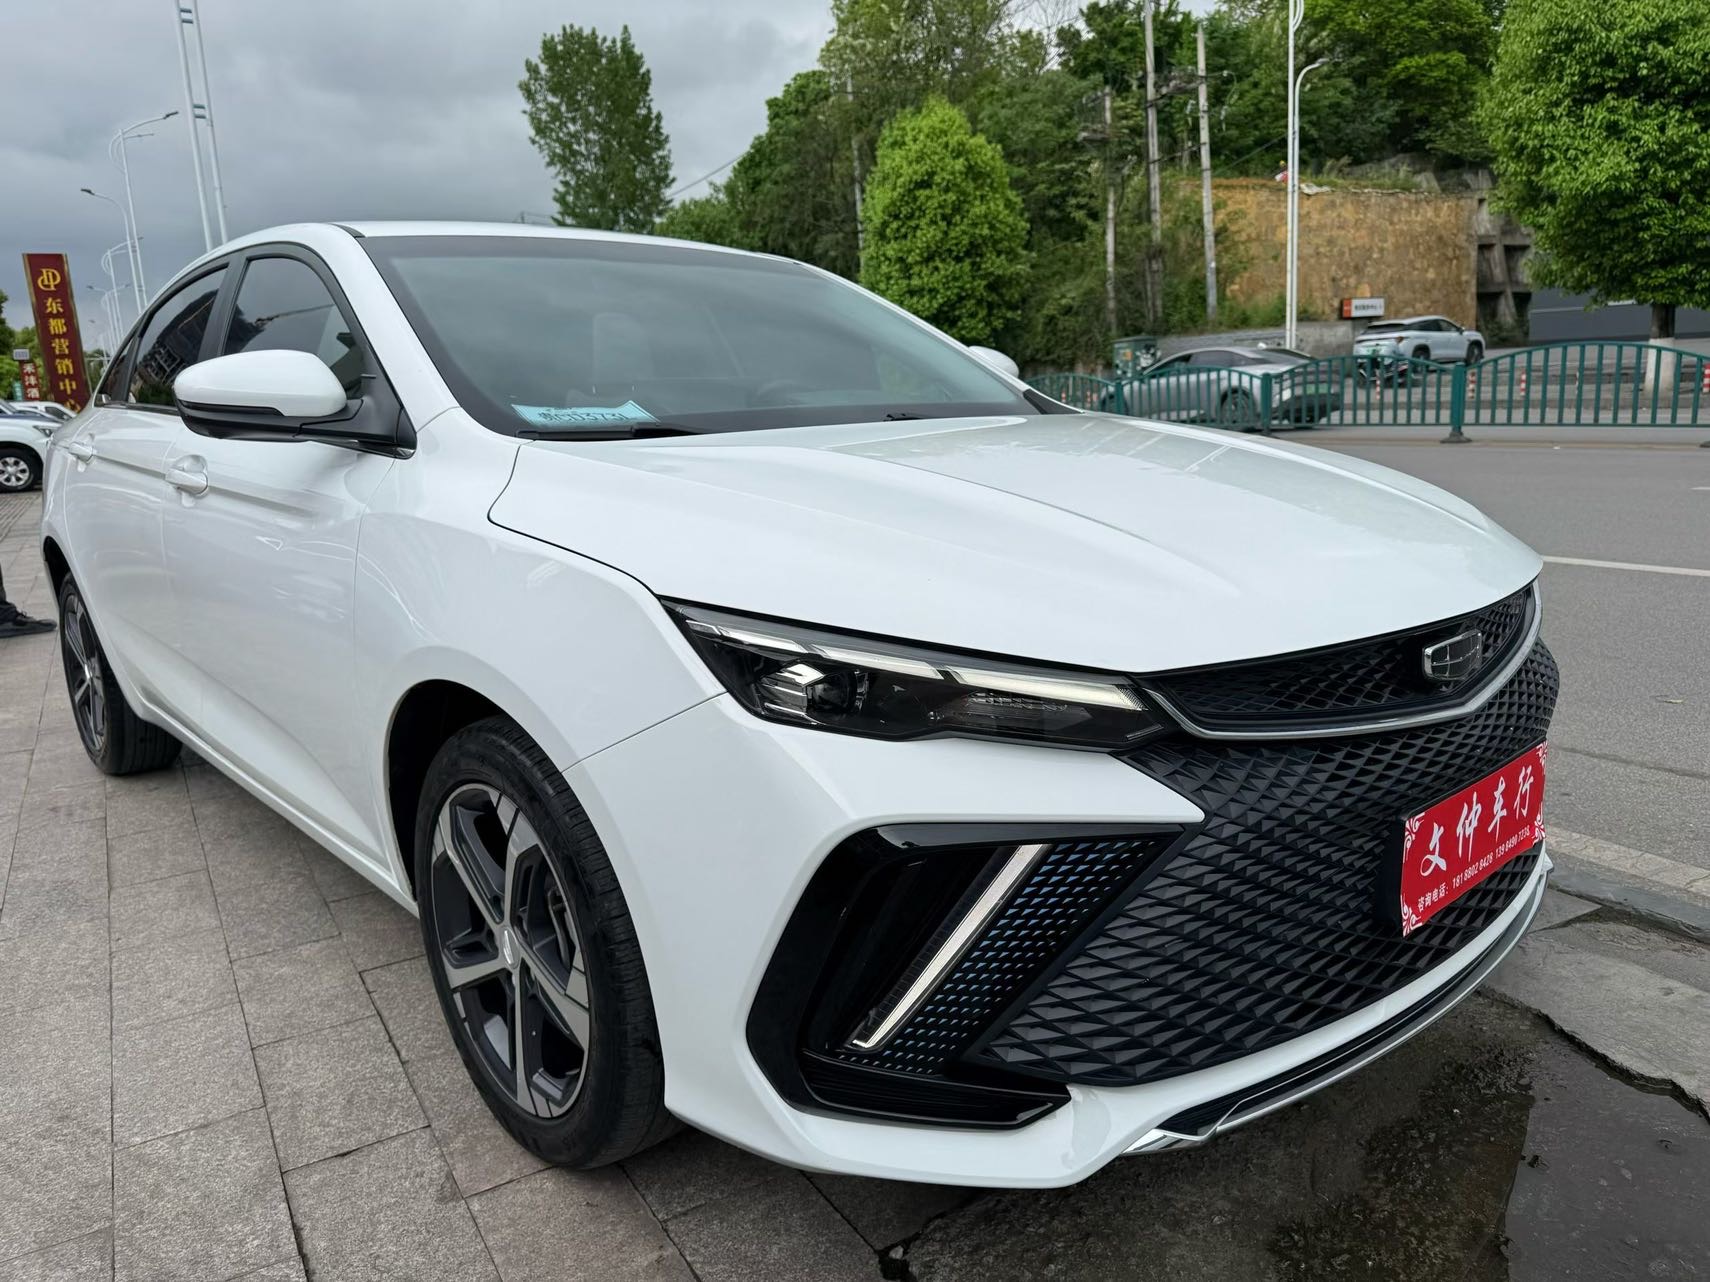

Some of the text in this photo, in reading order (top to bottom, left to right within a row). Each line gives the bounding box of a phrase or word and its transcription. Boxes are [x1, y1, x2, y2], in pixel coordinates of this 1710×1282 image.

[45, 297, 81, 413] 东都营销中心
[1420, 765, 1533, 877] 文仲车行
[1452, 872, 1463, 888] 181
[1464, 862, 1478, 881] 8802
[1495, 844, 1505, 859] 139
